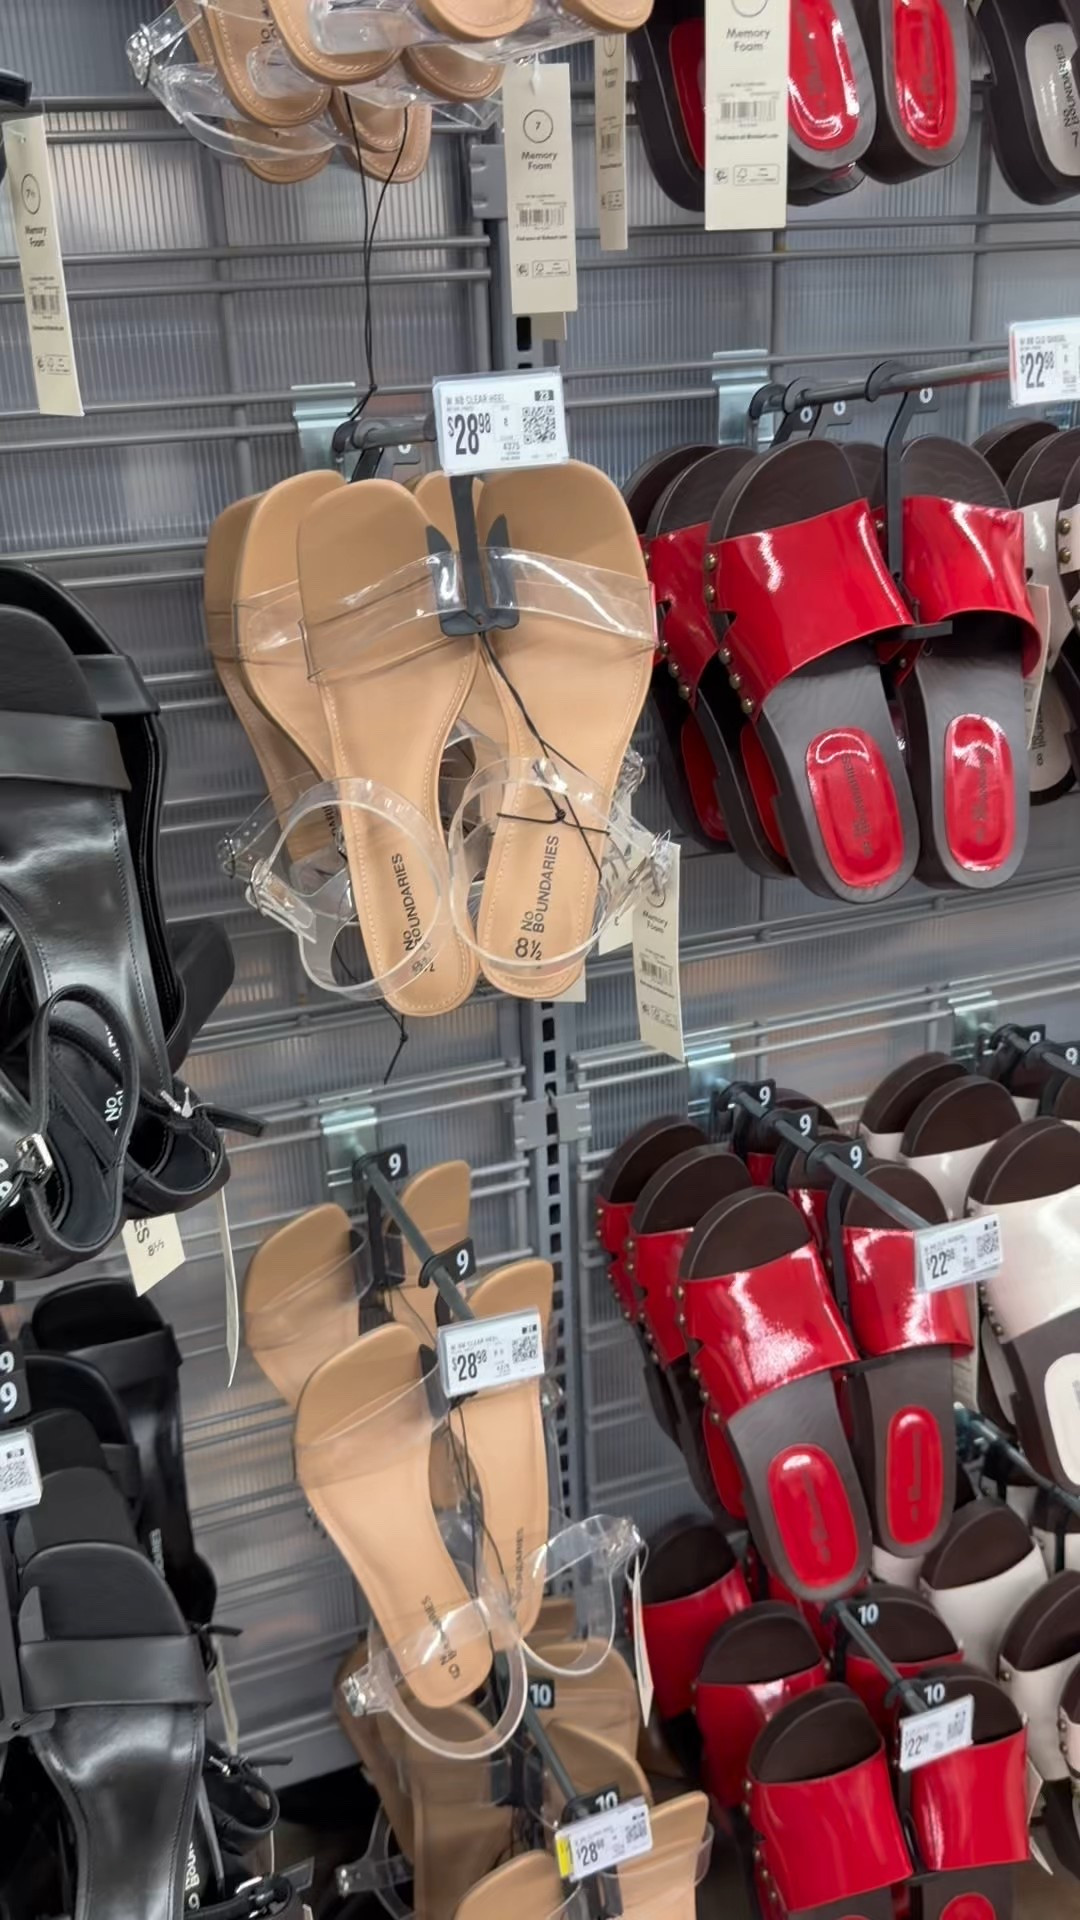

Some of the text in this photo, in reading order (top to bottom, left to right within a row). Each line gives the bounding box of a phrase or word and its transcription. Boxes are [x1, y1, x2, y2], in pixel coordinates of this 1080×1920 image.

[726, 28, 770, 40] Memory
[734, 42, 763, 52] Foam
[535, 121, 541, 131] 7
[521, 151, 558, 161] Memory
[527, 162, 552, 170] Foam
[25, 225, 47, 237] Memory
[533, 835, 559, 933] BOUNDARIES
[520, 911, 534, 932] NO
[403, 930, 417, 951] NO
[1066, 1047, 1078, 1065] 9
[759, 1086, 771, 1106] 9
[104, 1097, 120, 1122] NO
[800, 1114, 811, 1136] 9
[388, 1153, 401, 1176] 9
[850, 1145, 862, 1169] 9
[456, 1249, 469, 1275] 9
[0, 1351, 15, 1374] 9
[0, 1381, 18, 1414] 9
[858, 1604, 879, 1625] 10
[529, 1684, 552, 1706] 10
[923, 1683, 946, 1705] 10
[595, 1791, 618, 1812] 10
